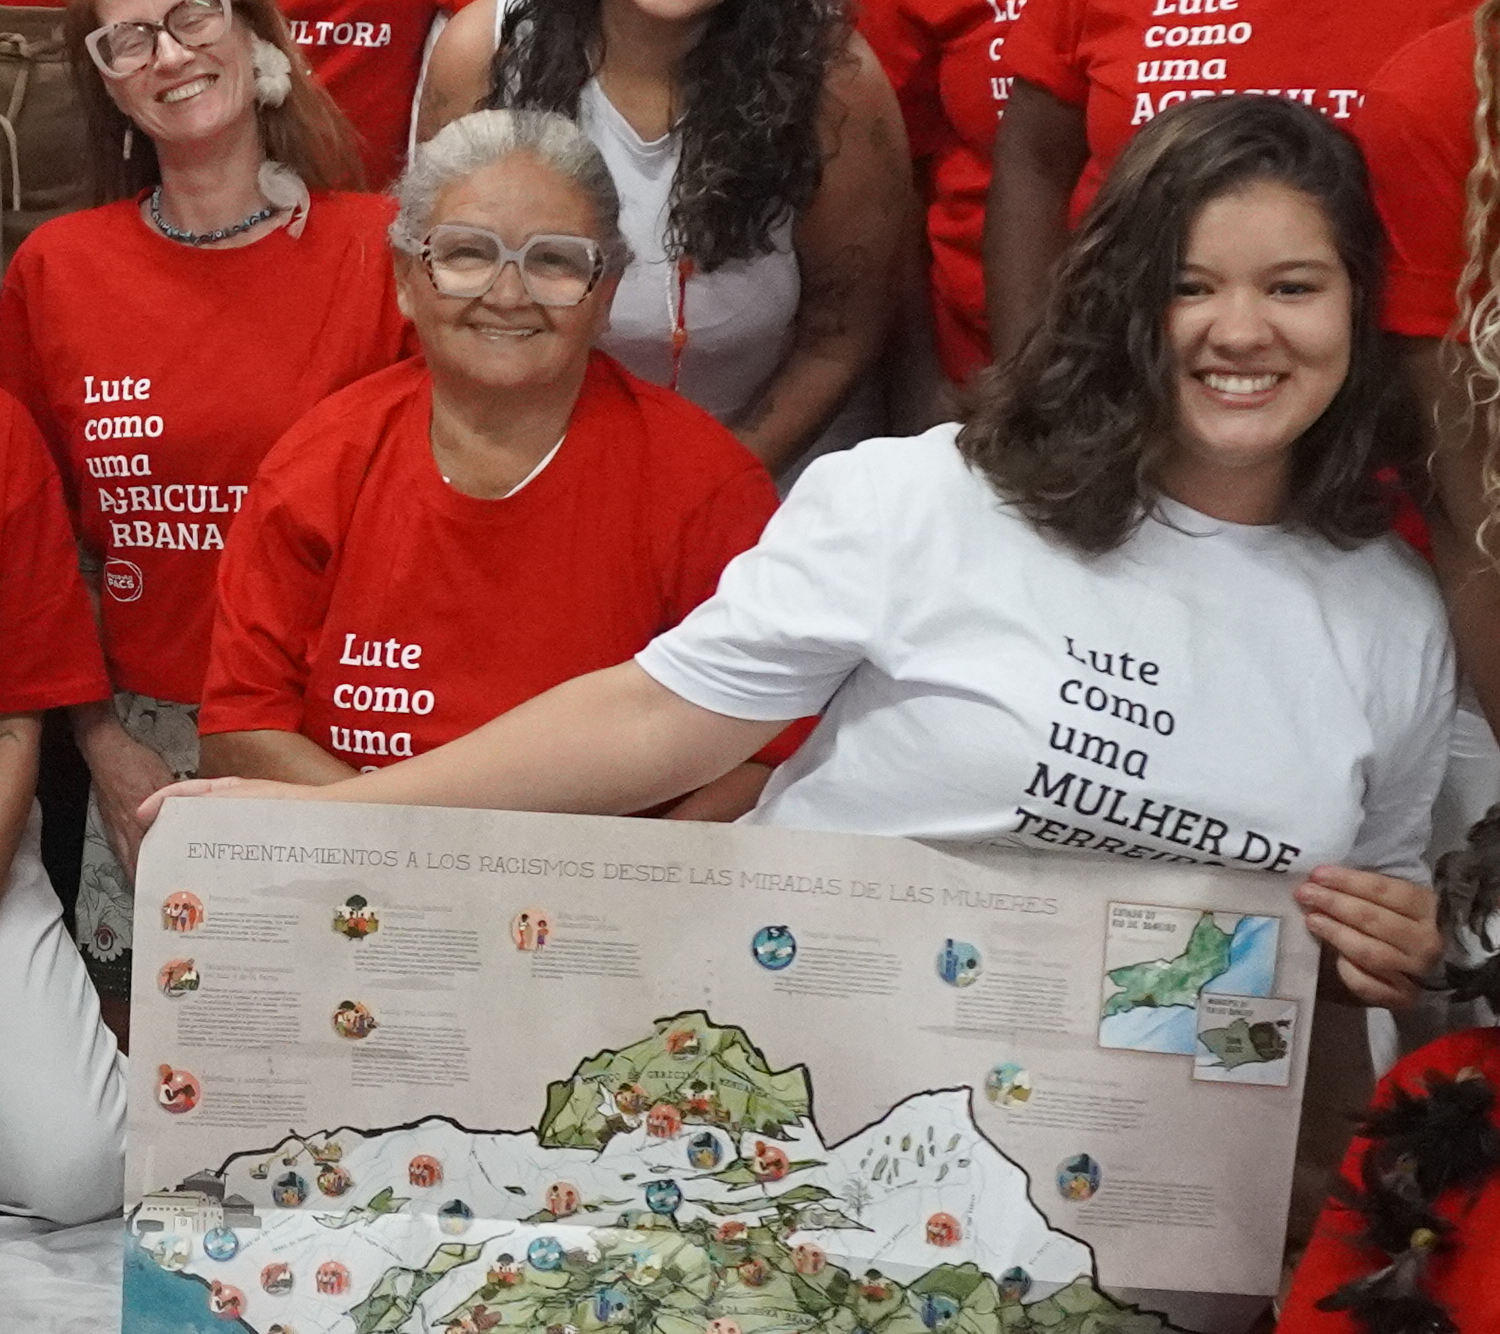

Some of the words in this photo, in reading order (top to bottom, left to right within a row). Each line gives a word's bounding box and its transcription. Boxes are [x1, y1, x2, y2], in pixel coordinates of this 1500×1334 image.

[1144, 21, 1252, 48] como
[1136, 57, 1227, 83] uma
[84, 376, 151, 404] Lute
[85, 415, 164, 441] como
[86, 454, 152, 478] uma
[109, 520, 224, 550] RBANA
[339, 633, 422, 669] Lute
[1063, 635, 1160, 686] Lute
[333, 683, 435, 715] como
[1059, 678, 1175, 737] como
[329, 725, 413, 757] uma
[1049, 722, 1149, 780] uma
[1024, 762, 1229, 857] MULHER
[1231, 830, 1301, 875] DE
[187, 843, 399, 867] ENFRENTAMIENTOS
[406, 851, 419, 868] A
[427, 852, 470, 871] LOS
[479, 855, 594, 878] RACISMOS
[603, 863, 682, 883] DESDE
[689, 868, 733, 887] LAS
[740, 871, 841, 896] MIRADAS
[850, 880, 881, 900] DE
[890, 885, 935, 904] LAS
[942, 888, 1058, 915] MUJERES
